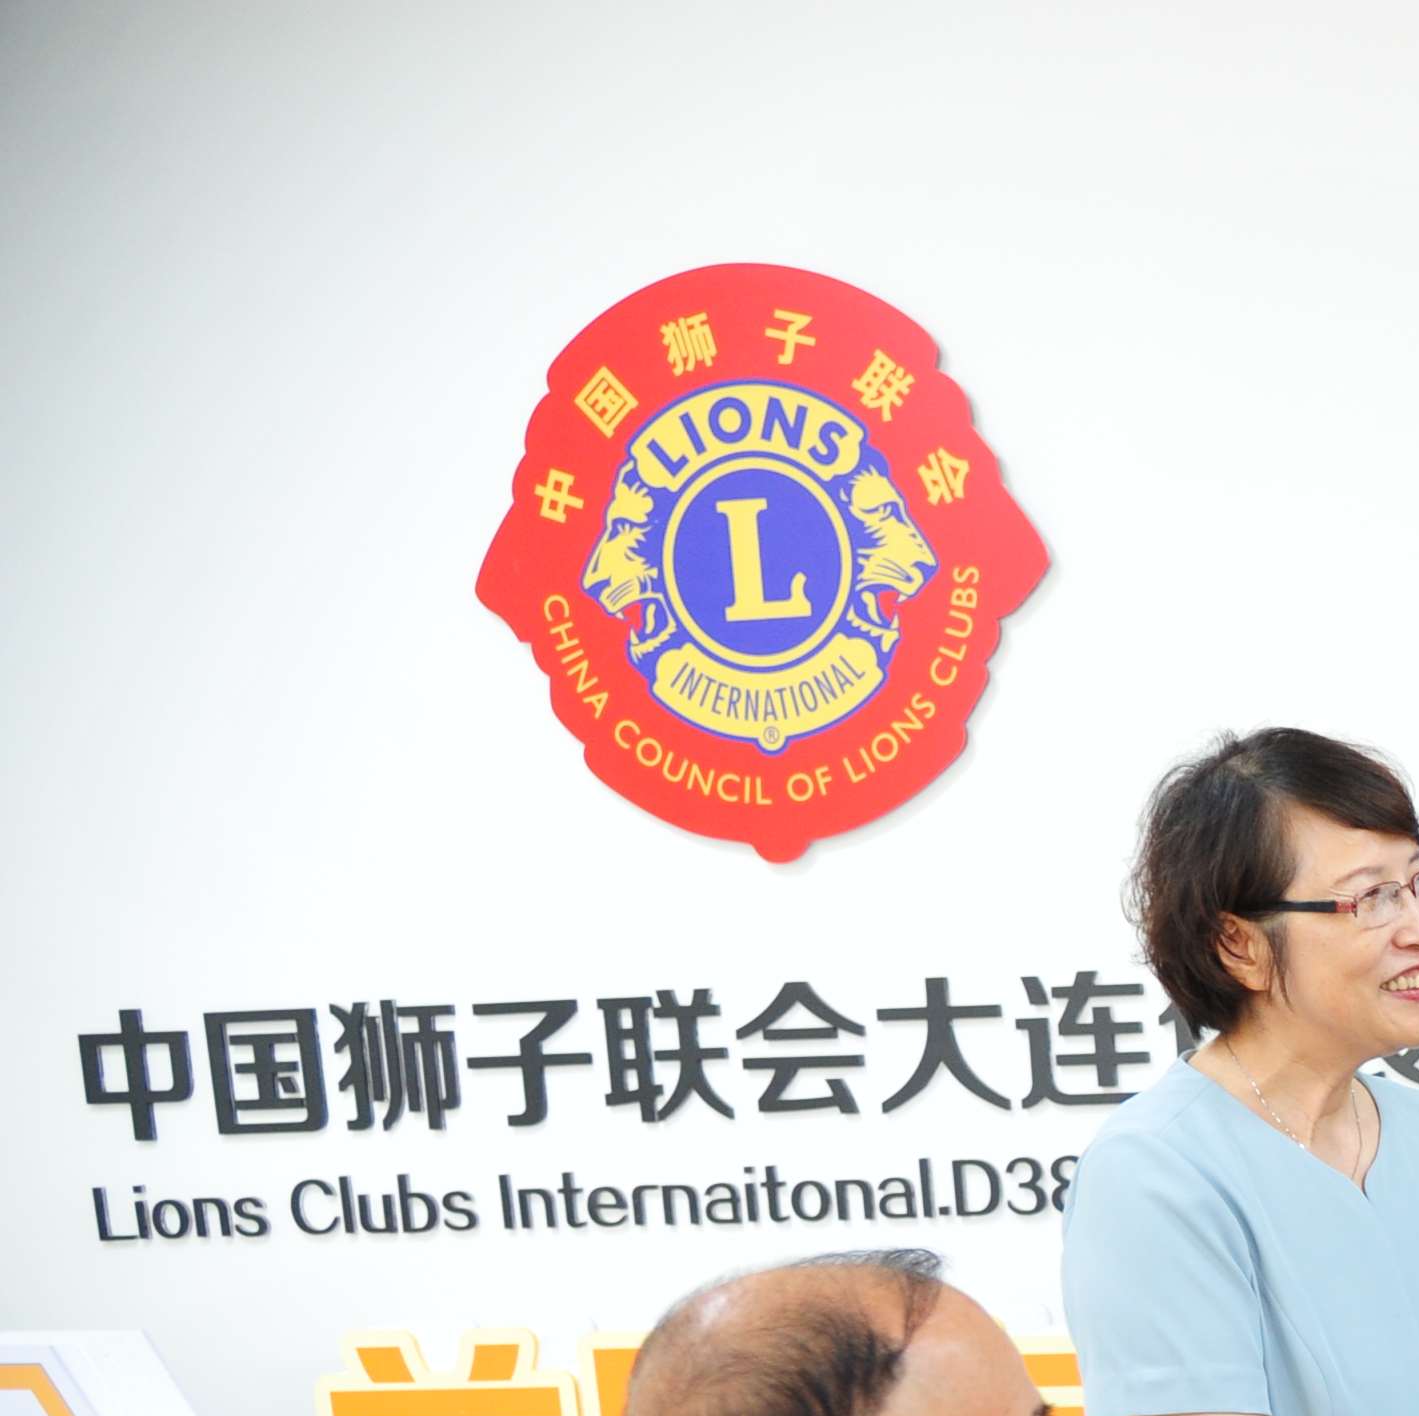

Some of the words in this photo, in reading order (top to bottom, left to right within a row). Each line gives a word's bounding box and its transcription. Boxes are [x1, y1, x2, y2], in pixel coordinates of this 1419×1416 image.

[534, 309, 971, 524] 中国狮子联会
[646, 396, 849, 478] LIONS
[716, 497, 812, 622] L
[543, 594, 610, 720] CHINA
[614, 719, 773, 805] COUNCIL
[786, 766, 833, 802] OF
[842, 692, 937, 783] LIONS
[929, 566, 980, 686] CLUBS
[670, 654, 867, 723] INTERNATIONAL
[92, 1185, 271, 1243] Lions
[291, 1173, 479, 1236] Clubs
